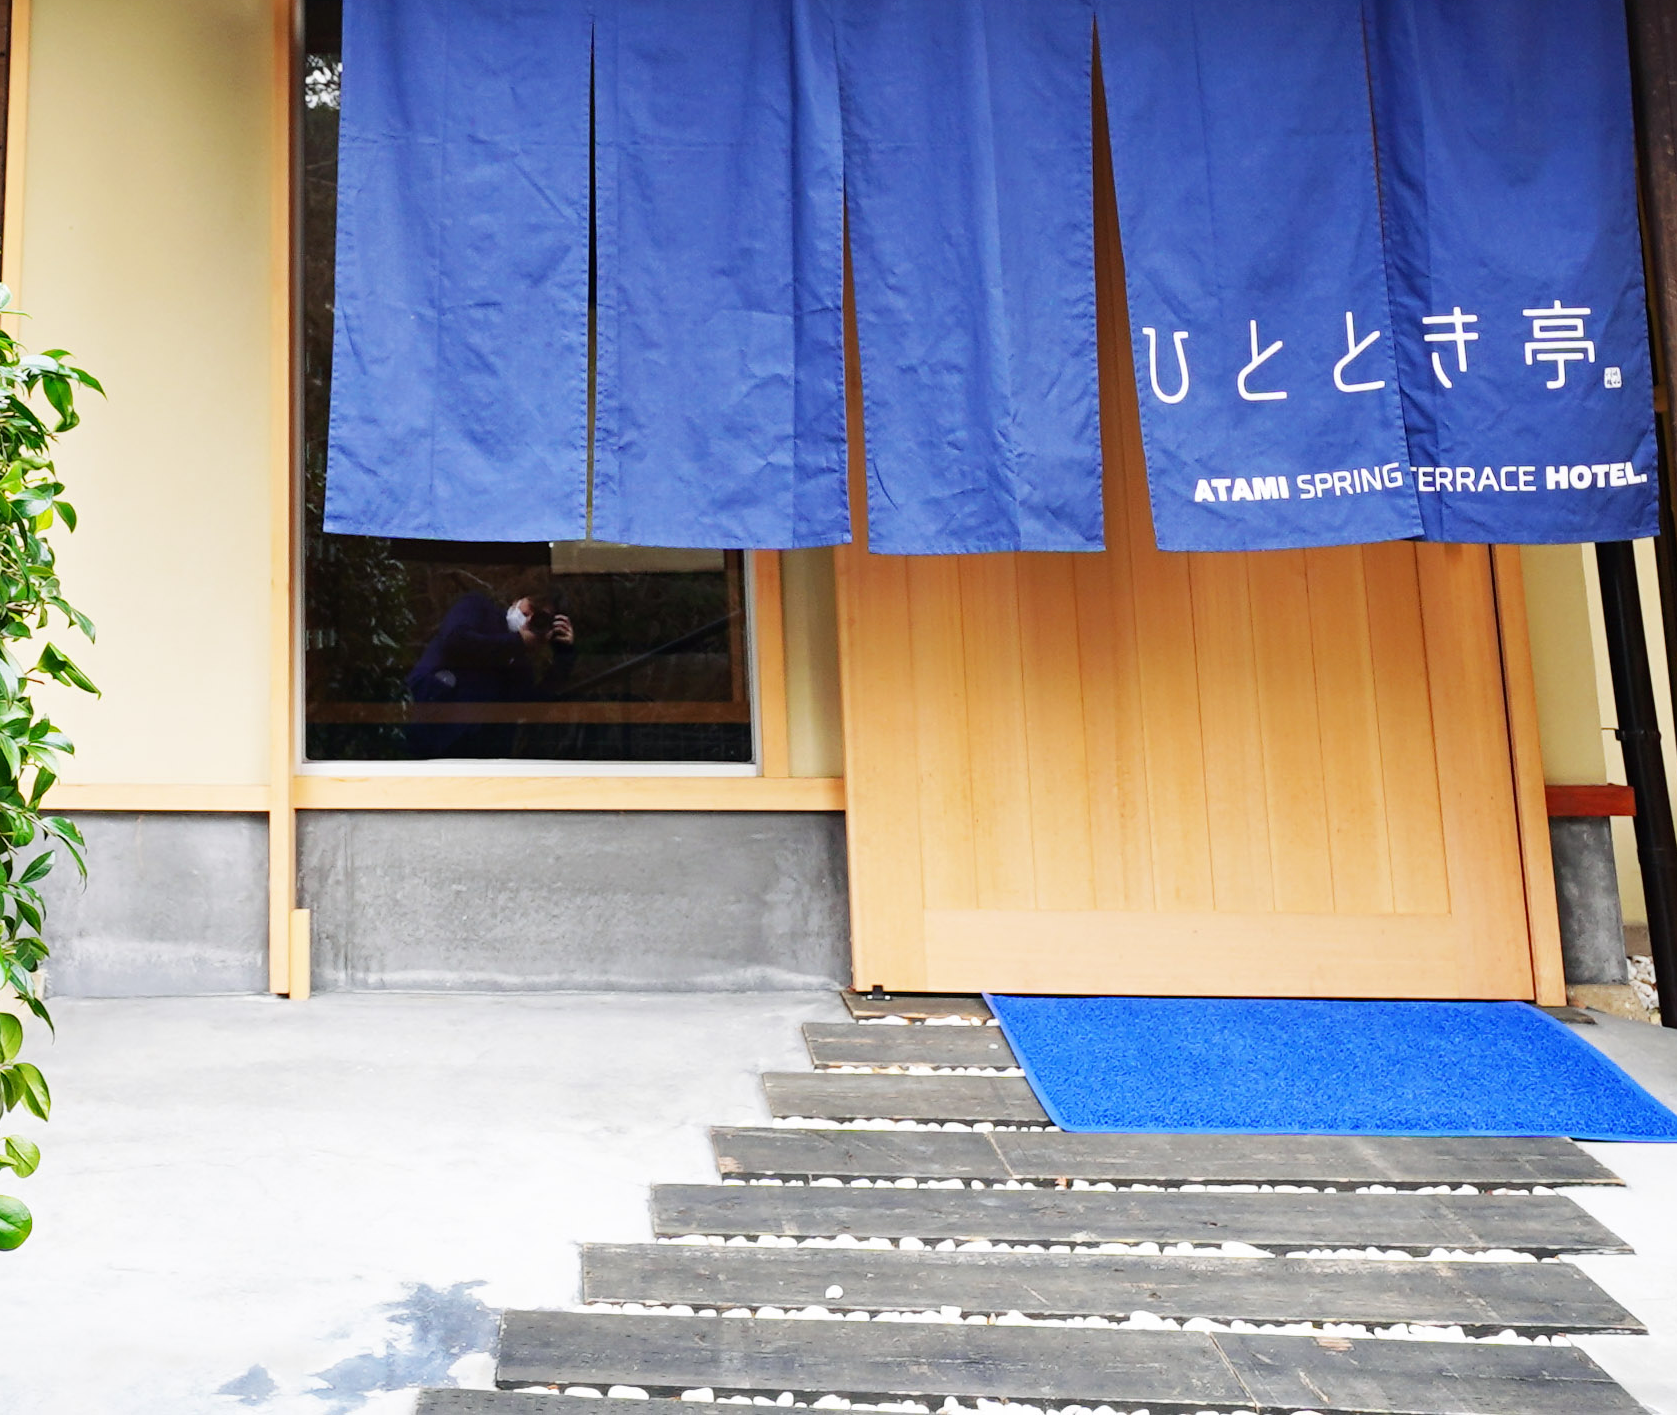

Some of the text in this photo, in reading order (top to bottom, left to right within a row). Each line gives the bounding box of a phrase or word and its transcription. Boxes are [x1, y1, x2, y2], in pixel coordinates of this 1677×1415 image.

[1141, 299, 1597, 405] ひととき亭
[1193, 475, 1290, 504] ATAMI
[1297, 461, 1404, 500] SPRING
[1545, 460, 1648, 491] HOTEL.
